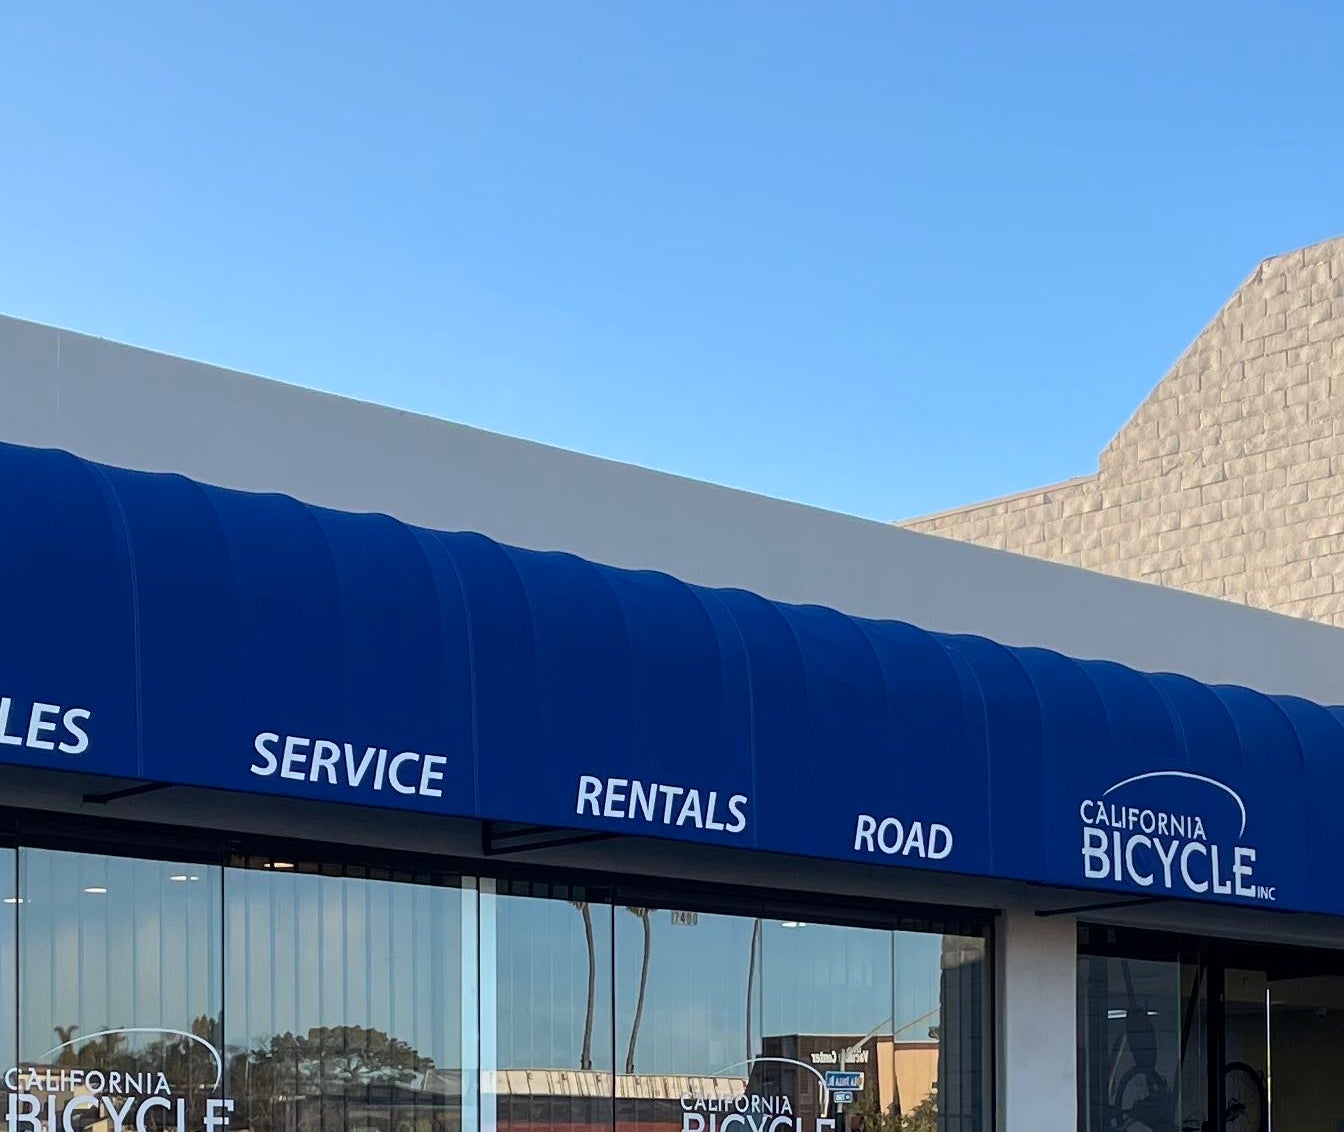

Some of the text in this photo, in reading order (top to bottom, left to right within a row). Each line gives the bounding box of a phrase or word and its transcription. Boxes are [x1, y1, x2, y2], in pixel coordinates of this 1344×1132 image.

[250, 732, 448, 798] SERVICE
[576, 775, 748, 833] RENTALS
[1080, 799, 1207, 841] CALIFORNIA
[854, 814, 953, 860] ROAD
[1082, 826, 1276, 901] BICYCLE INC
[5, 1067, 171, 1095] CALIFORNIA
[681, 1091, 793, 1115] CALIFORNIA
